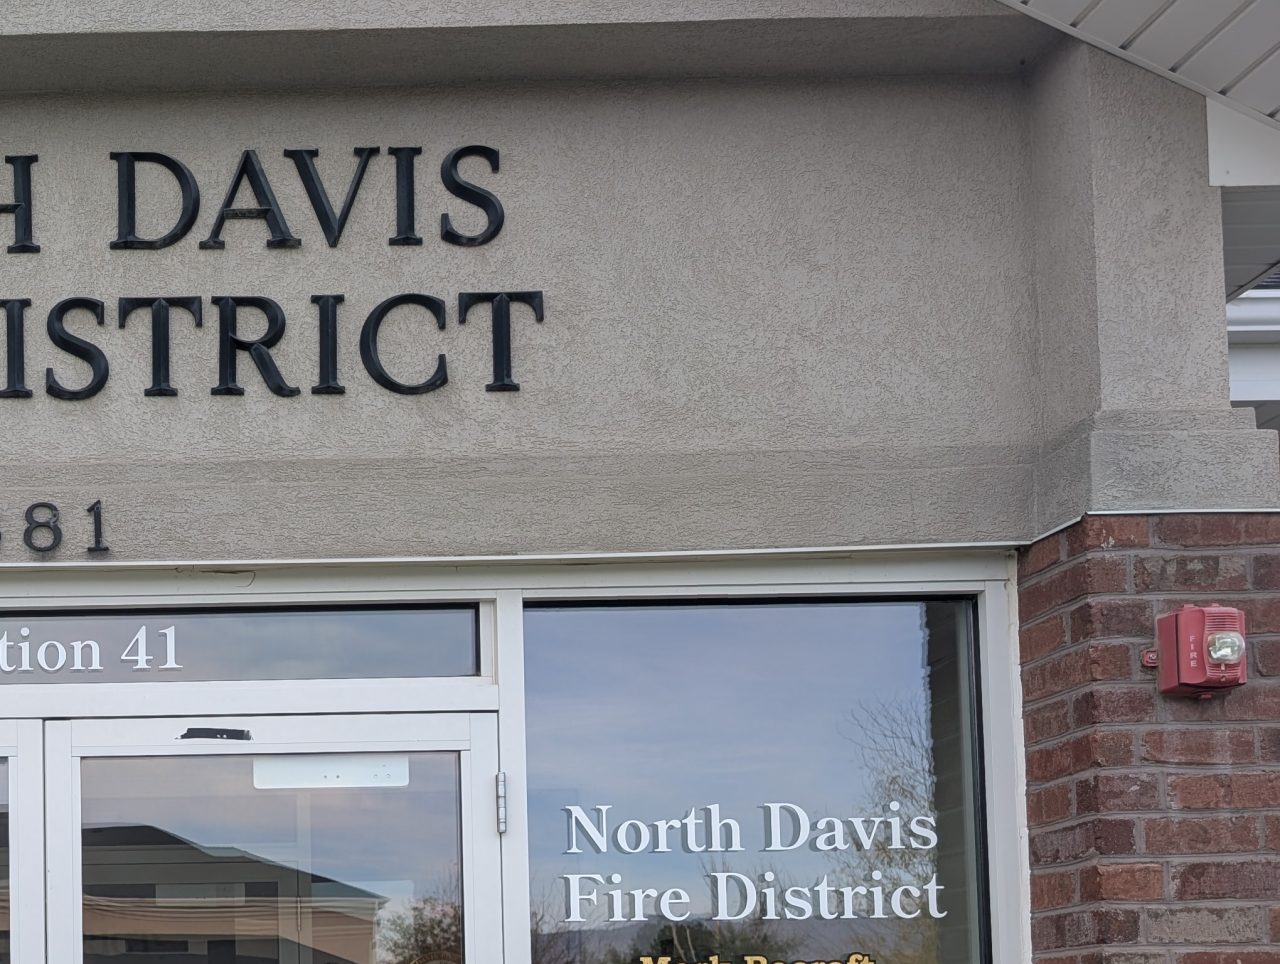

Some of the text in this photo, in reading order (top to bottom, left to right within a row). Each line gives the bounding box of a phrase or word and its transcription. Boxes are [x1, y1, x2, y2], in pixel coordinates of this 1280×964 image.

[109, 145, 505, 251] DAVIS
[120, 625, 184, 670] 41
[1189, 635, 1198, 667] FIRE
[564, 800, 939, 854] North Davis
[563, 870, 948, 923] Fire District
